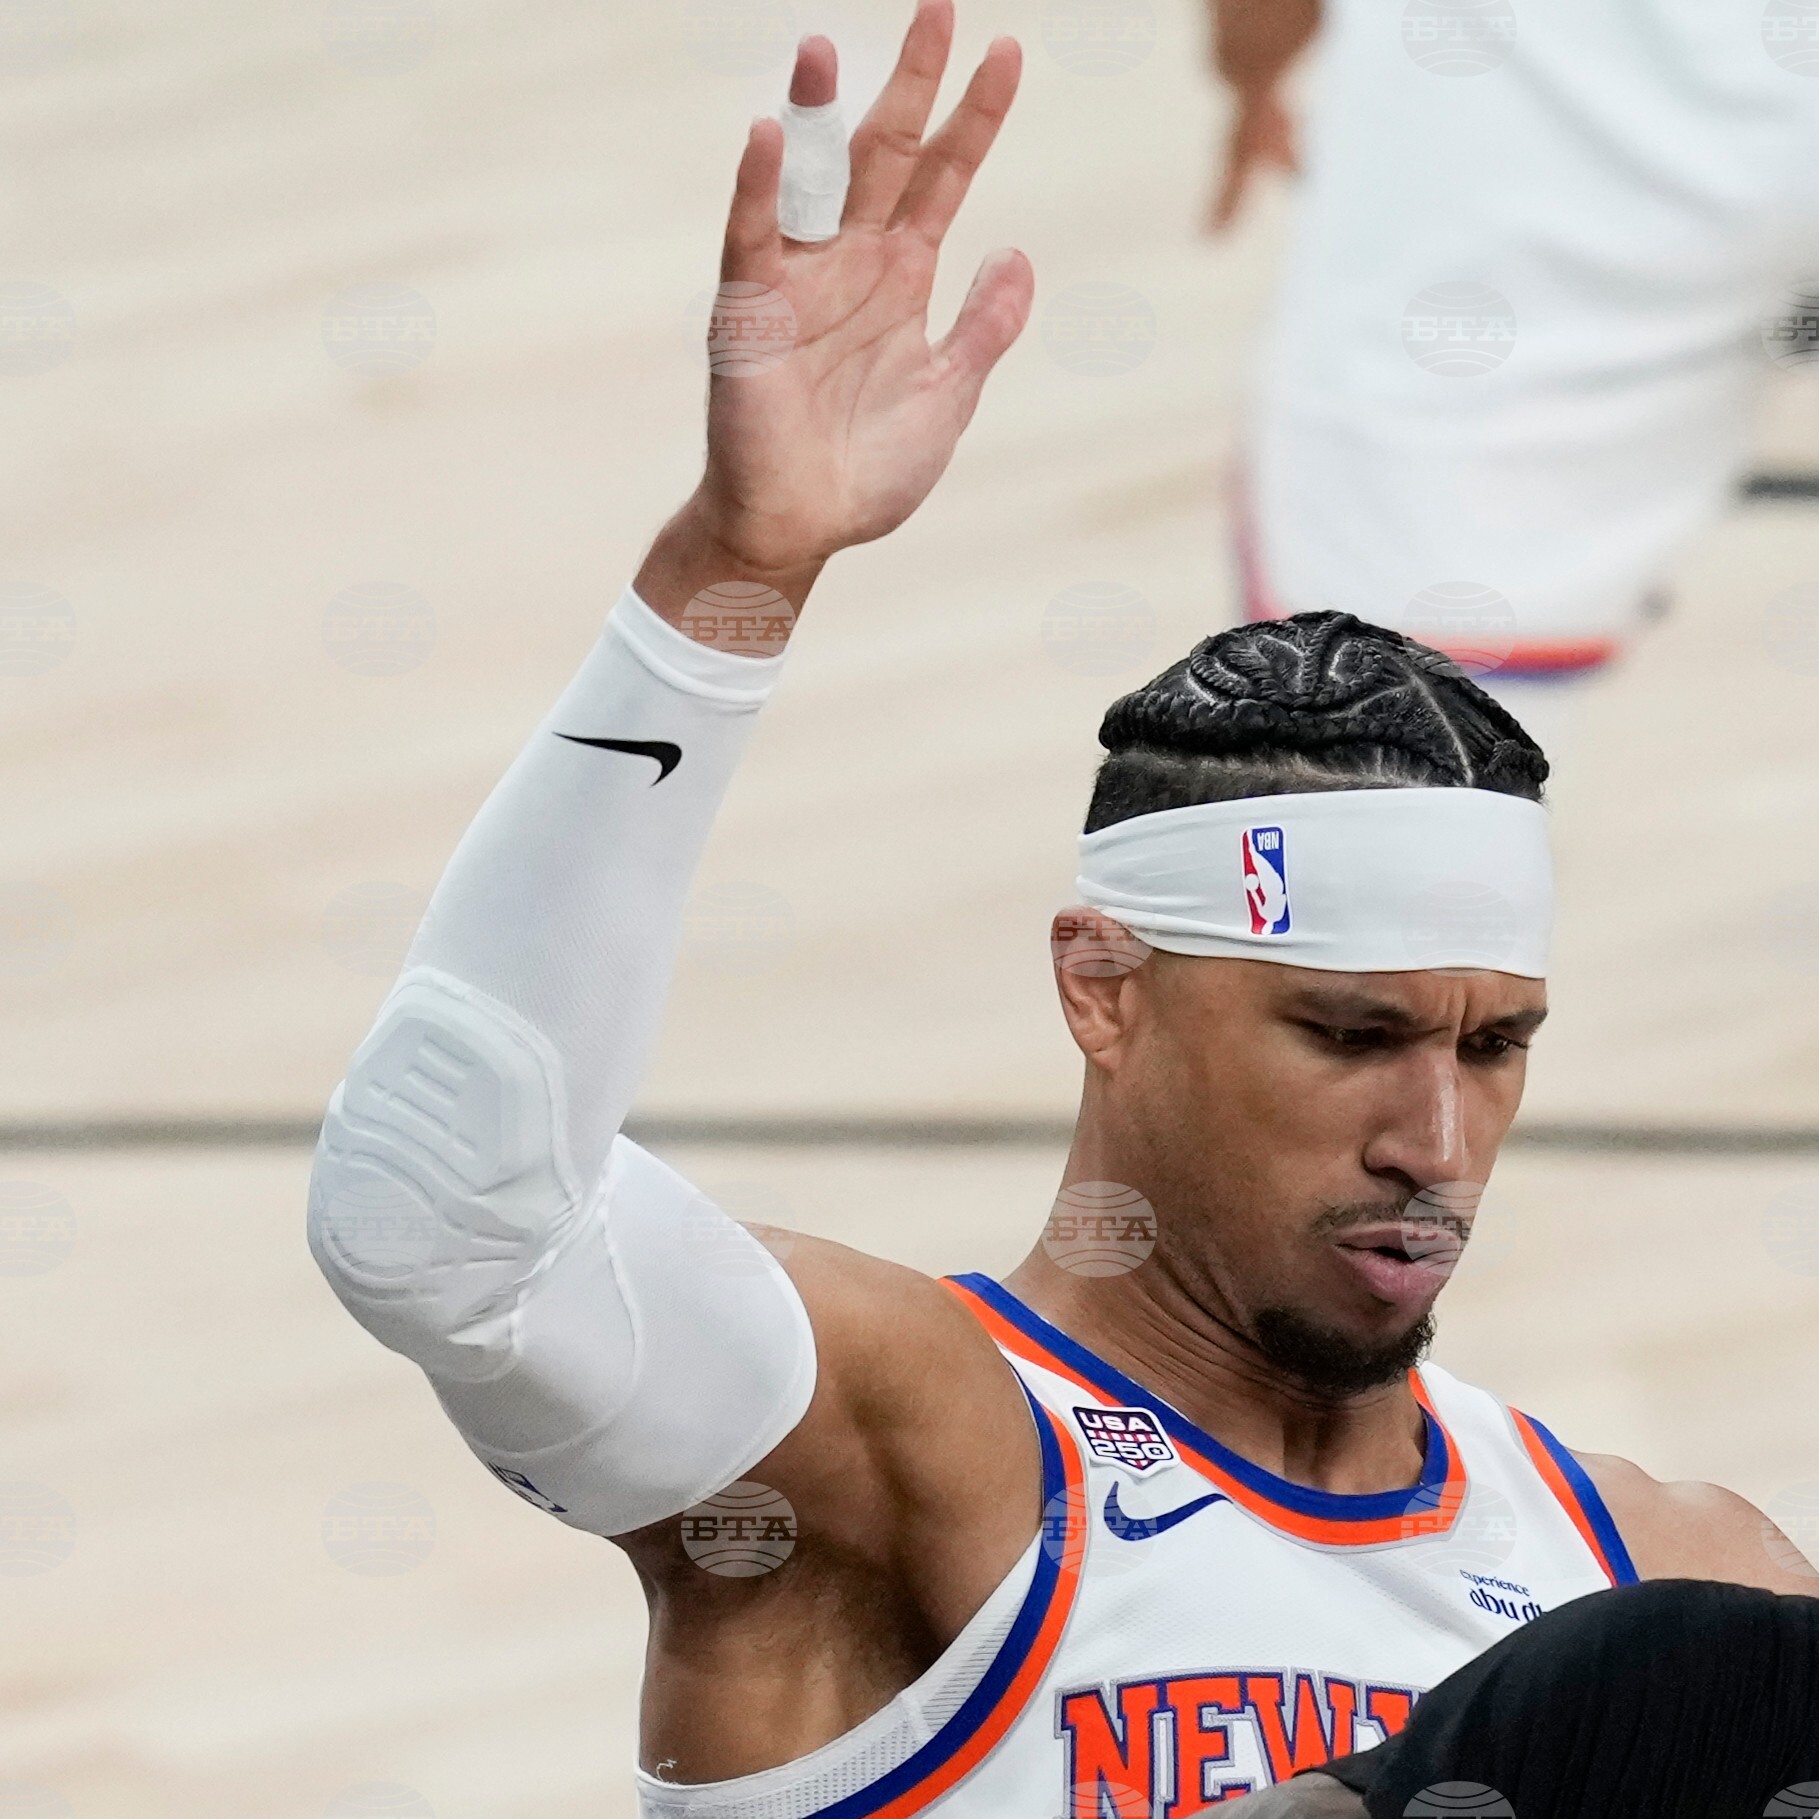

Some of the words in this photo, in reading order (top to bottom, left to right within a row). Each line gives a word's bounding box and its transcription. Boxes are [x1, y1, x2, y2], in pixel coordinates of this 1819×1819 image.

[1256, 830, 1280, 851] NBA
[1078, 1411, 1153, 1432] USA
[1090, 1438, 1173, 1460] 250
[1469, 1588, 1520, 1621] abu
